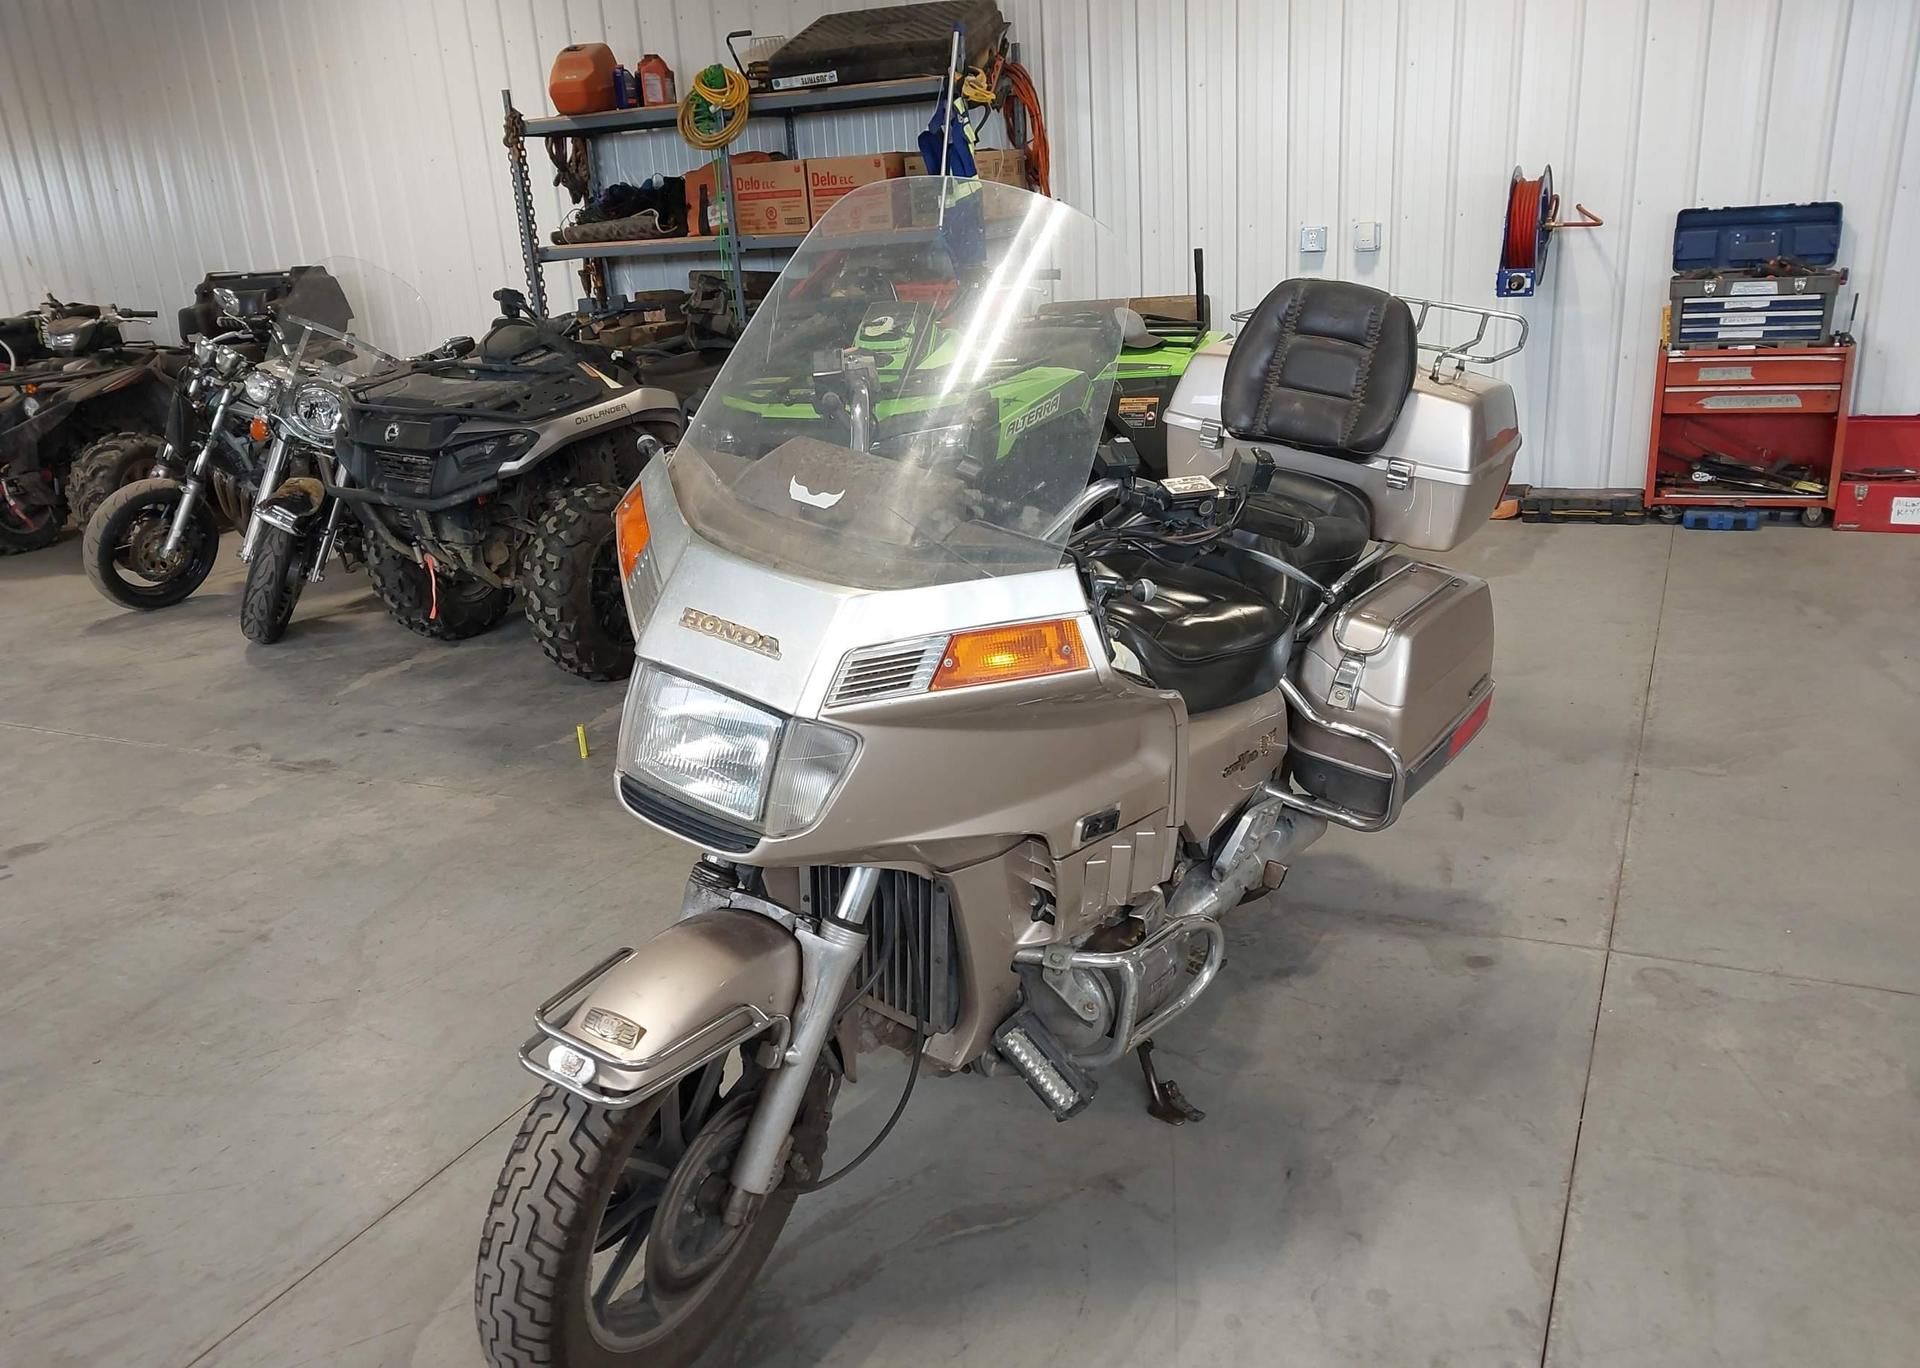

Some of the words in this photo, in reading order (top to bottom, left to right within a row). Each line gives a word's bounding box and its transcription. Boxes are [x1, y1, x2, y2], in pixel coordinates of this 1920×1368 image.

[736, 176, 760, 192] Delo
[762, 180, 776, 190] ELC
[811, 172, 837, 187] Delo
[839, 175, 855, 185] ELC
[575, 402, 628, 425] OUTLANDER
[1006, 394, 1060, 438] ALTERRA
[680, 607, 780, 658] HONDA
